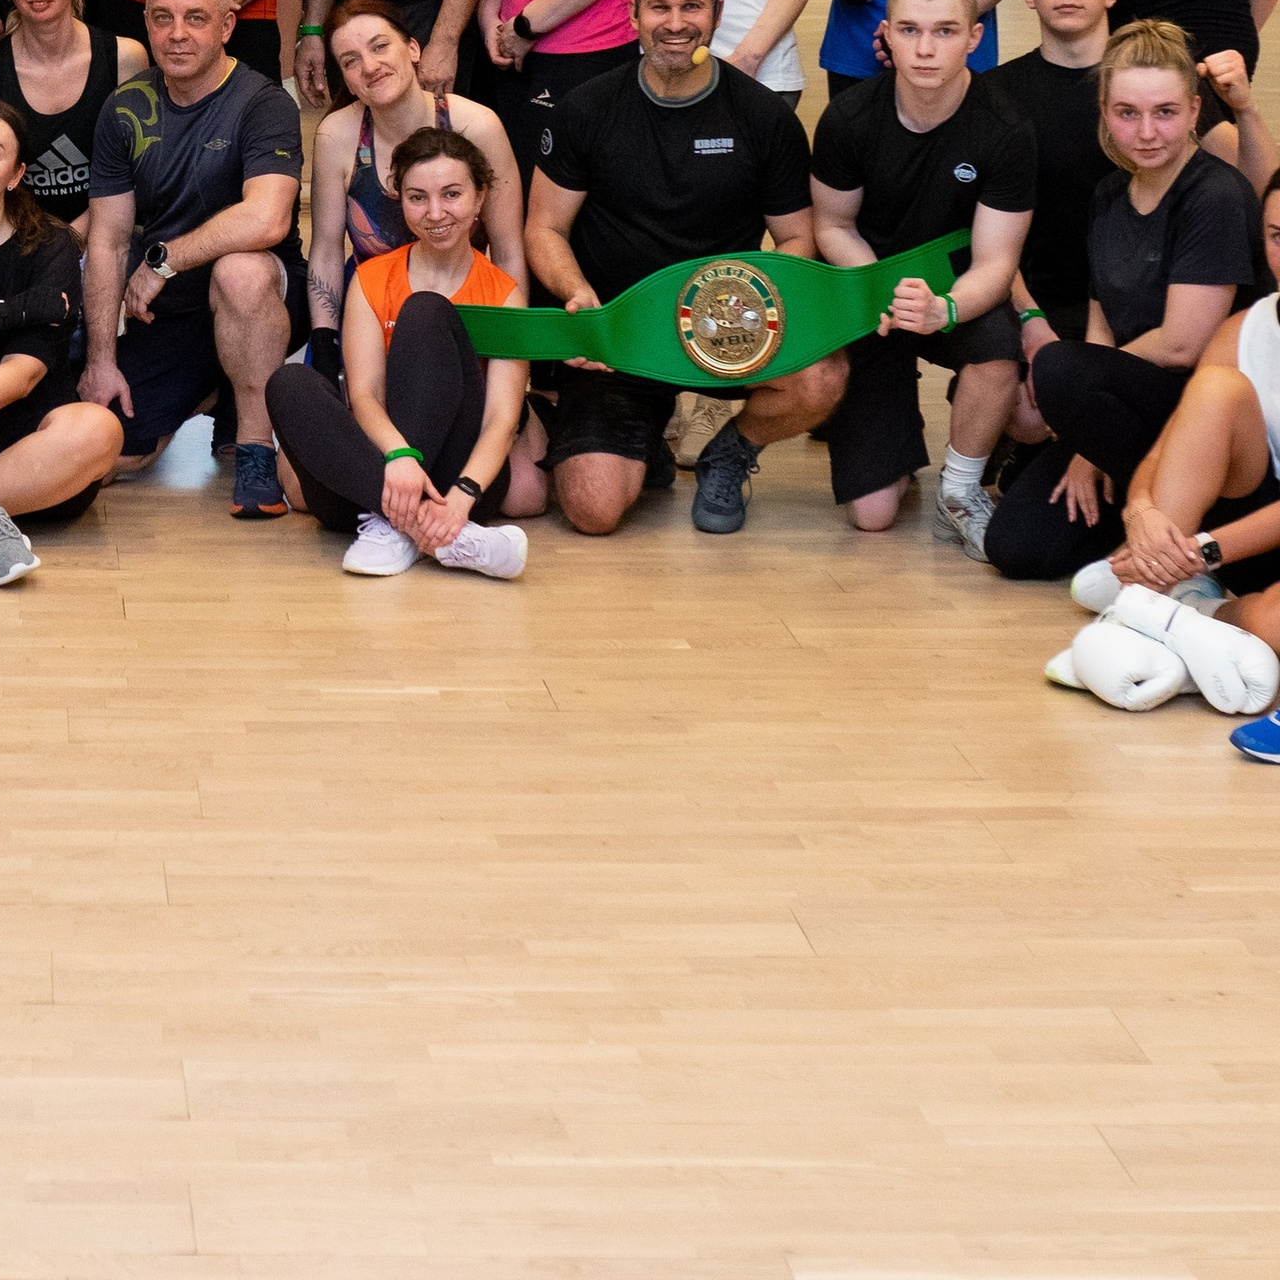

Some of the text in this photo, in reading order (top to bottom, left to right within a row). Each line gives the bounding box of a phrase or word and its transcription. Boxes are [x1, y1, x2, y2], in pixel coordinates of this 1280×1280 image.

[23, 166, 90, 187] adida
[34, 182, 90, 196] RUNNING
[709, 333, 755, 347] WBC
